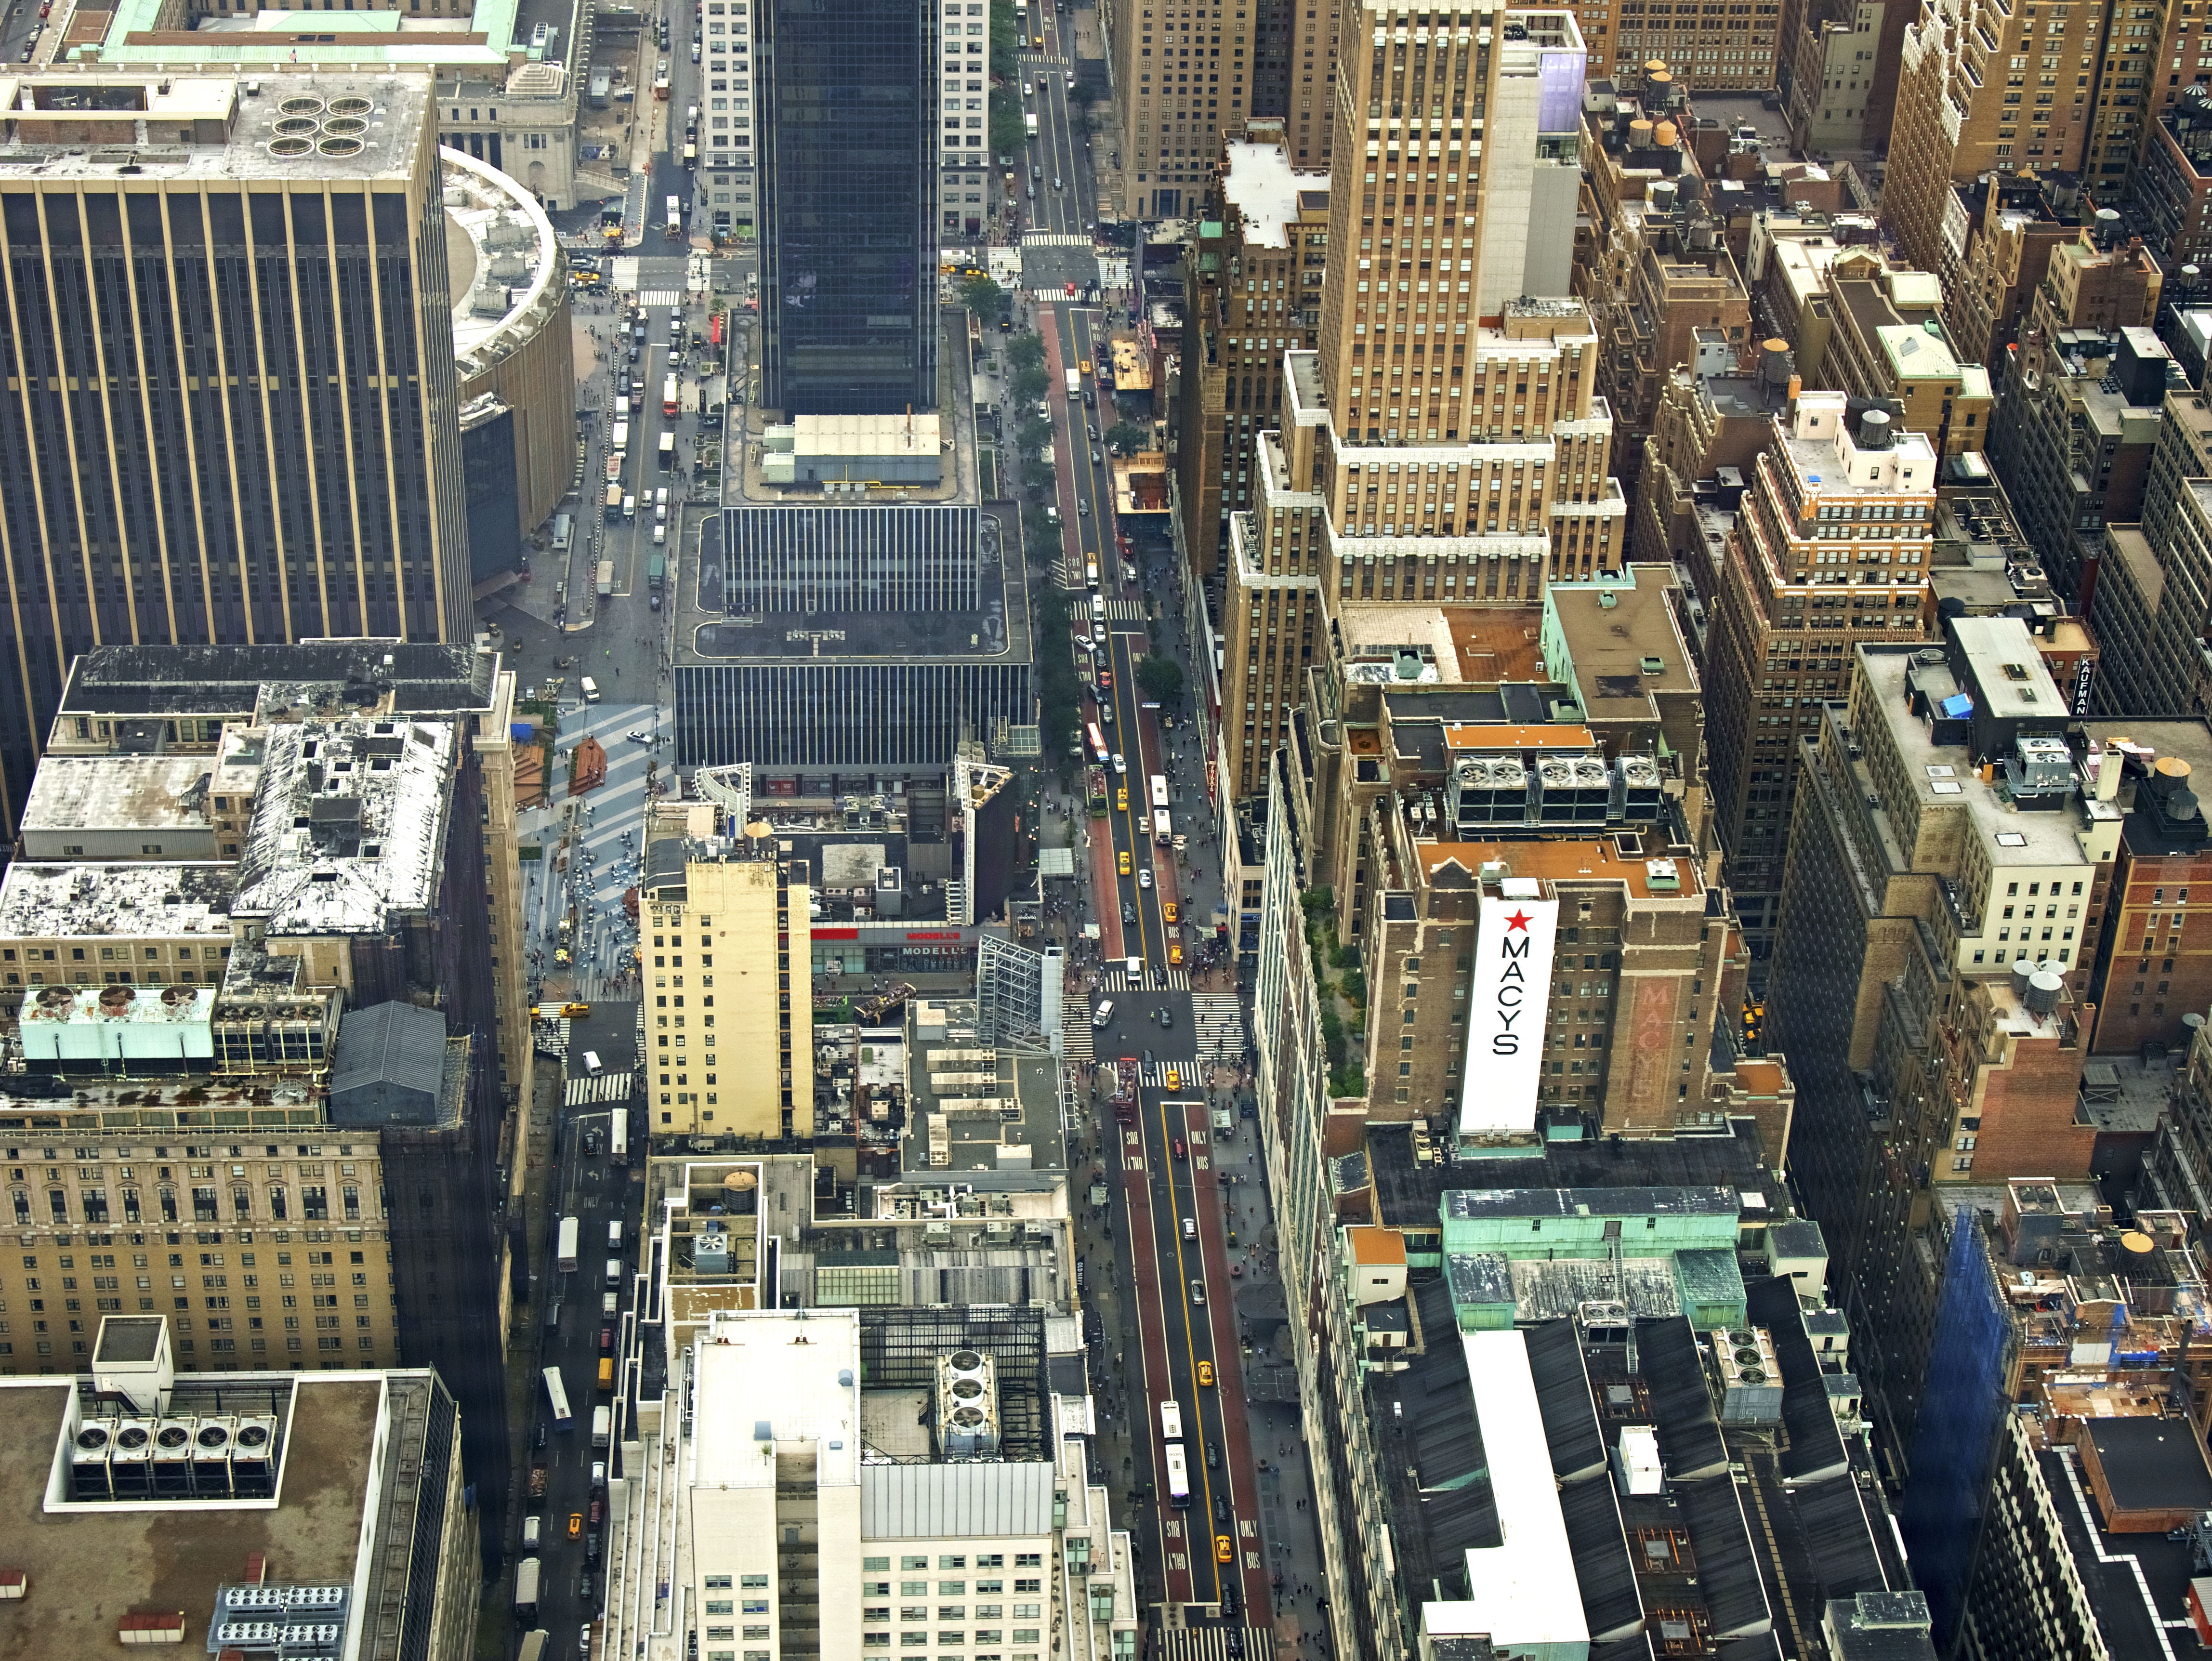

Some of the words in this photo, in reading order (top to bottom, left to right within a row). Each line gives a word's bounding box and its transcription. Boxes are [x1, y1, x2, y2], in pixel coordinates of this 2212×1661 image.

[1068, 557, 1080, 567] BUS
[1068, 571, 1082, 580] ONLY
[1078, 653, 1088, 663] BUS
[1079, 671, 1092, 681] ONLY
[2077, 658, 2090, 714] KAUFMAN
[1168, 926, 1180, 939] BUS
[1492, 936, 1529, 1055] MACYS
[1126, 1131, 1138, 1145] BUS
[1191, 1131, 1206, 1145] ONLY
[1127, 1156, 1143, 1170] ONLY
[1196, 1156, 1209, 1170] BUS
[583, 1196, 600, 1209] ONLY
[1167, 1521, 1180, 1538] BUS
[1240, 1520, 1257, 1538] ONLY
[1168, 1553, 1186, 1570] ONLY
[1246, 1552, 1261, 1569] BUS
